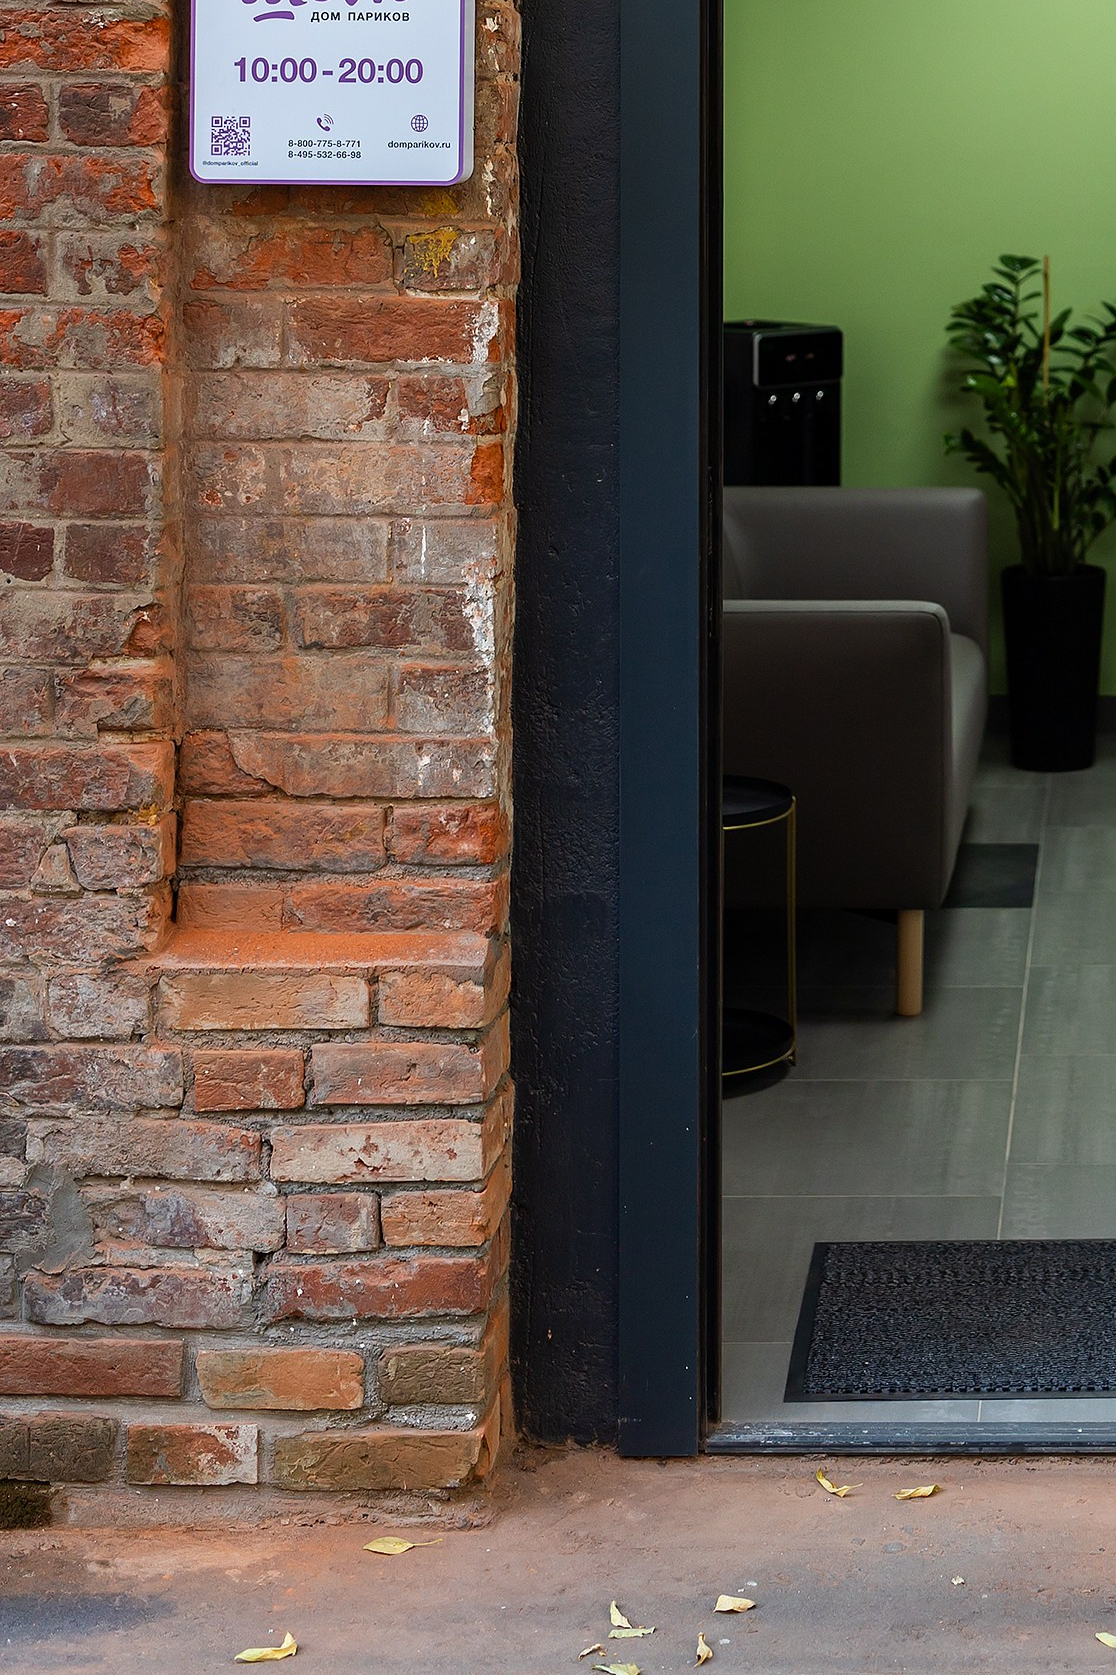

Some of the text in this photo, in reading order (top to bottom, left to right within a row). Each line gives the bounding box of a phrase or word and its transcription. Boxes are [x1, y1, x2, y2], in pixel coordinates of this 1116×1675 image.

[310, 11, 410, 23] ДОМ ПАРИКОВ
[287, 139, 361, 148] 8-800-775-8-771
[387, 140, 451, 150] domparikov.ru
[287, 150, 362, 159] 8-495-532-66-98
